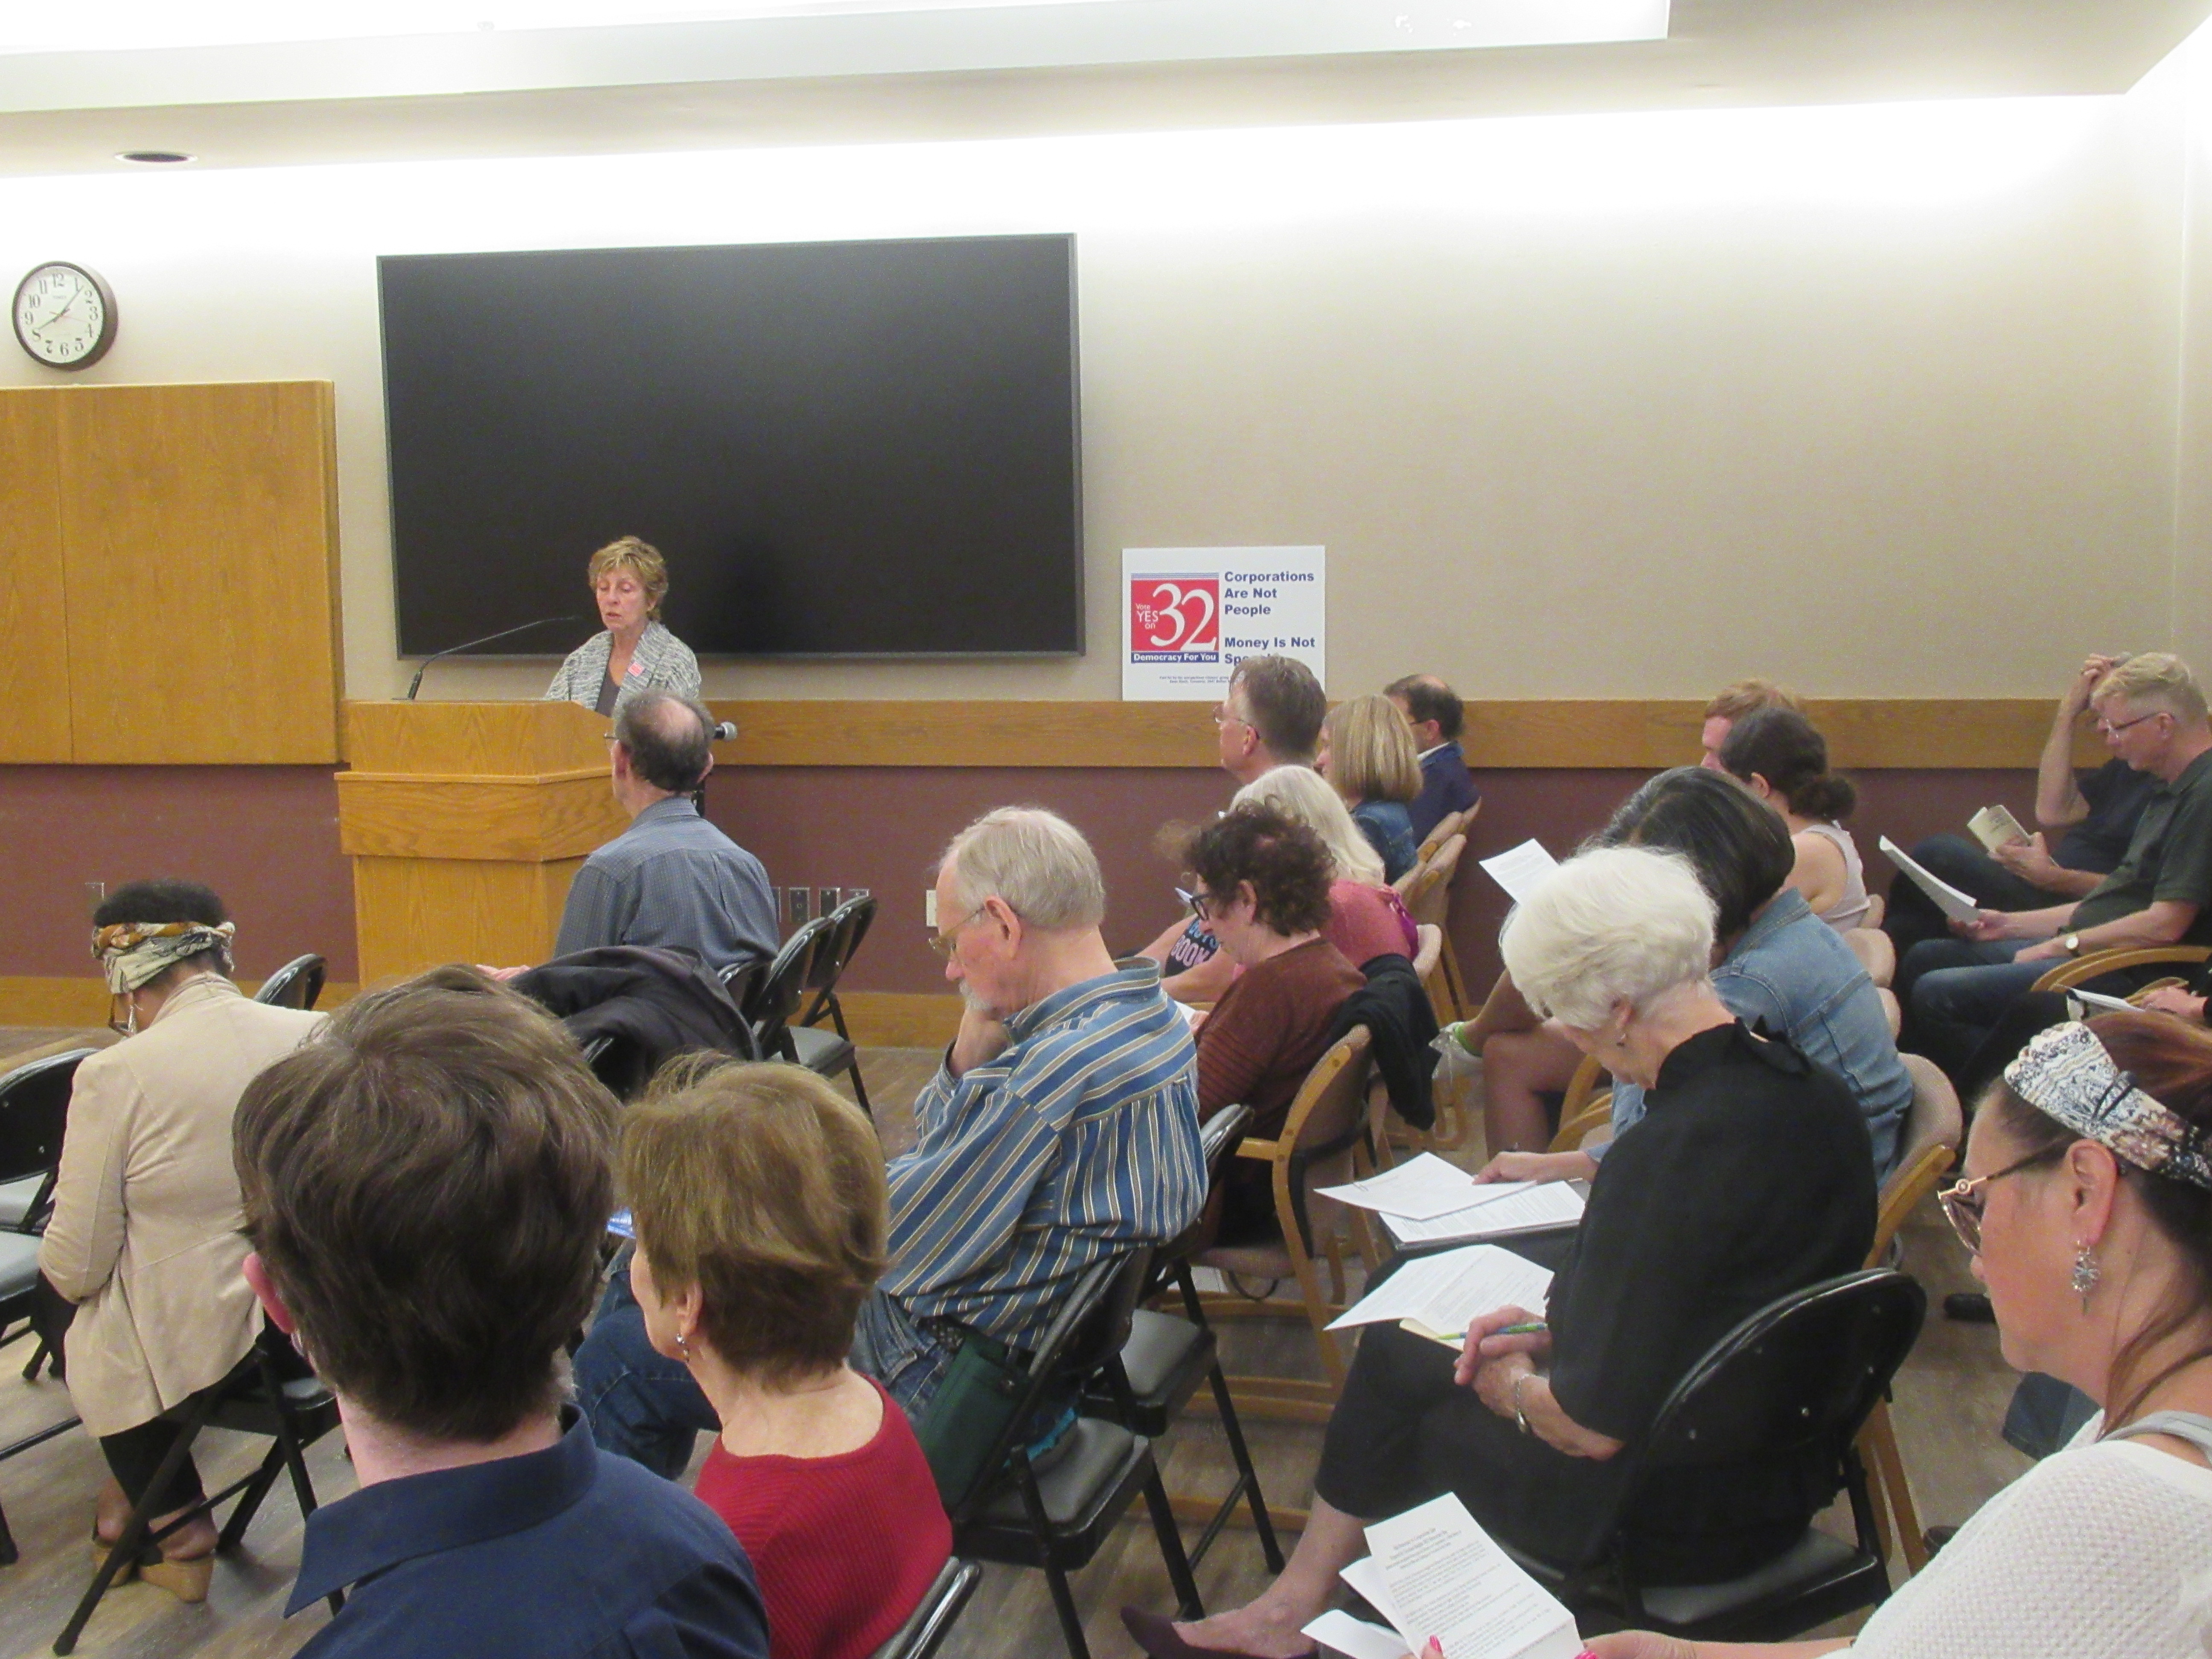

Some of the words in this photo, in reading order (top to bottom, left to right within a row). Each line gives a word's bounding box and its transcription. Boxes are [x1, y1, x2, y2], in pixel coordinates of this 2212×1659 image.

[38, 279, 47, 294] 11
[52, 273, 64, 288] 12
[28, 294, 41, 309] 10
[84, 289, 93, 304] 2
[24, 311, 34, 325] 9
[89, 306, 99, 321] 3
[45, 339, 53, 354] 7
[59, 341, 69, 356] 6
[74, 337, 84, 352] 5
[1224, 571, 1314, 584] Corporations
[1224, 588, 1249, 598] Are
[1253, 588, 1278, 598] Not
[1136, 610, 1159, 623] YES
[1151, 583, 1217, 651] 32
[1225, 604, 1271, 617] People
[1225, 637, 1269, 650] Money
[1274, 637, 1286, 648] Is
[1291, 636, 1315, 648] Not
[1133, 653, 1182, 662] Democracy
[1184, 653, 1198, 661] For
[1200, 652, 1217, 661] You
